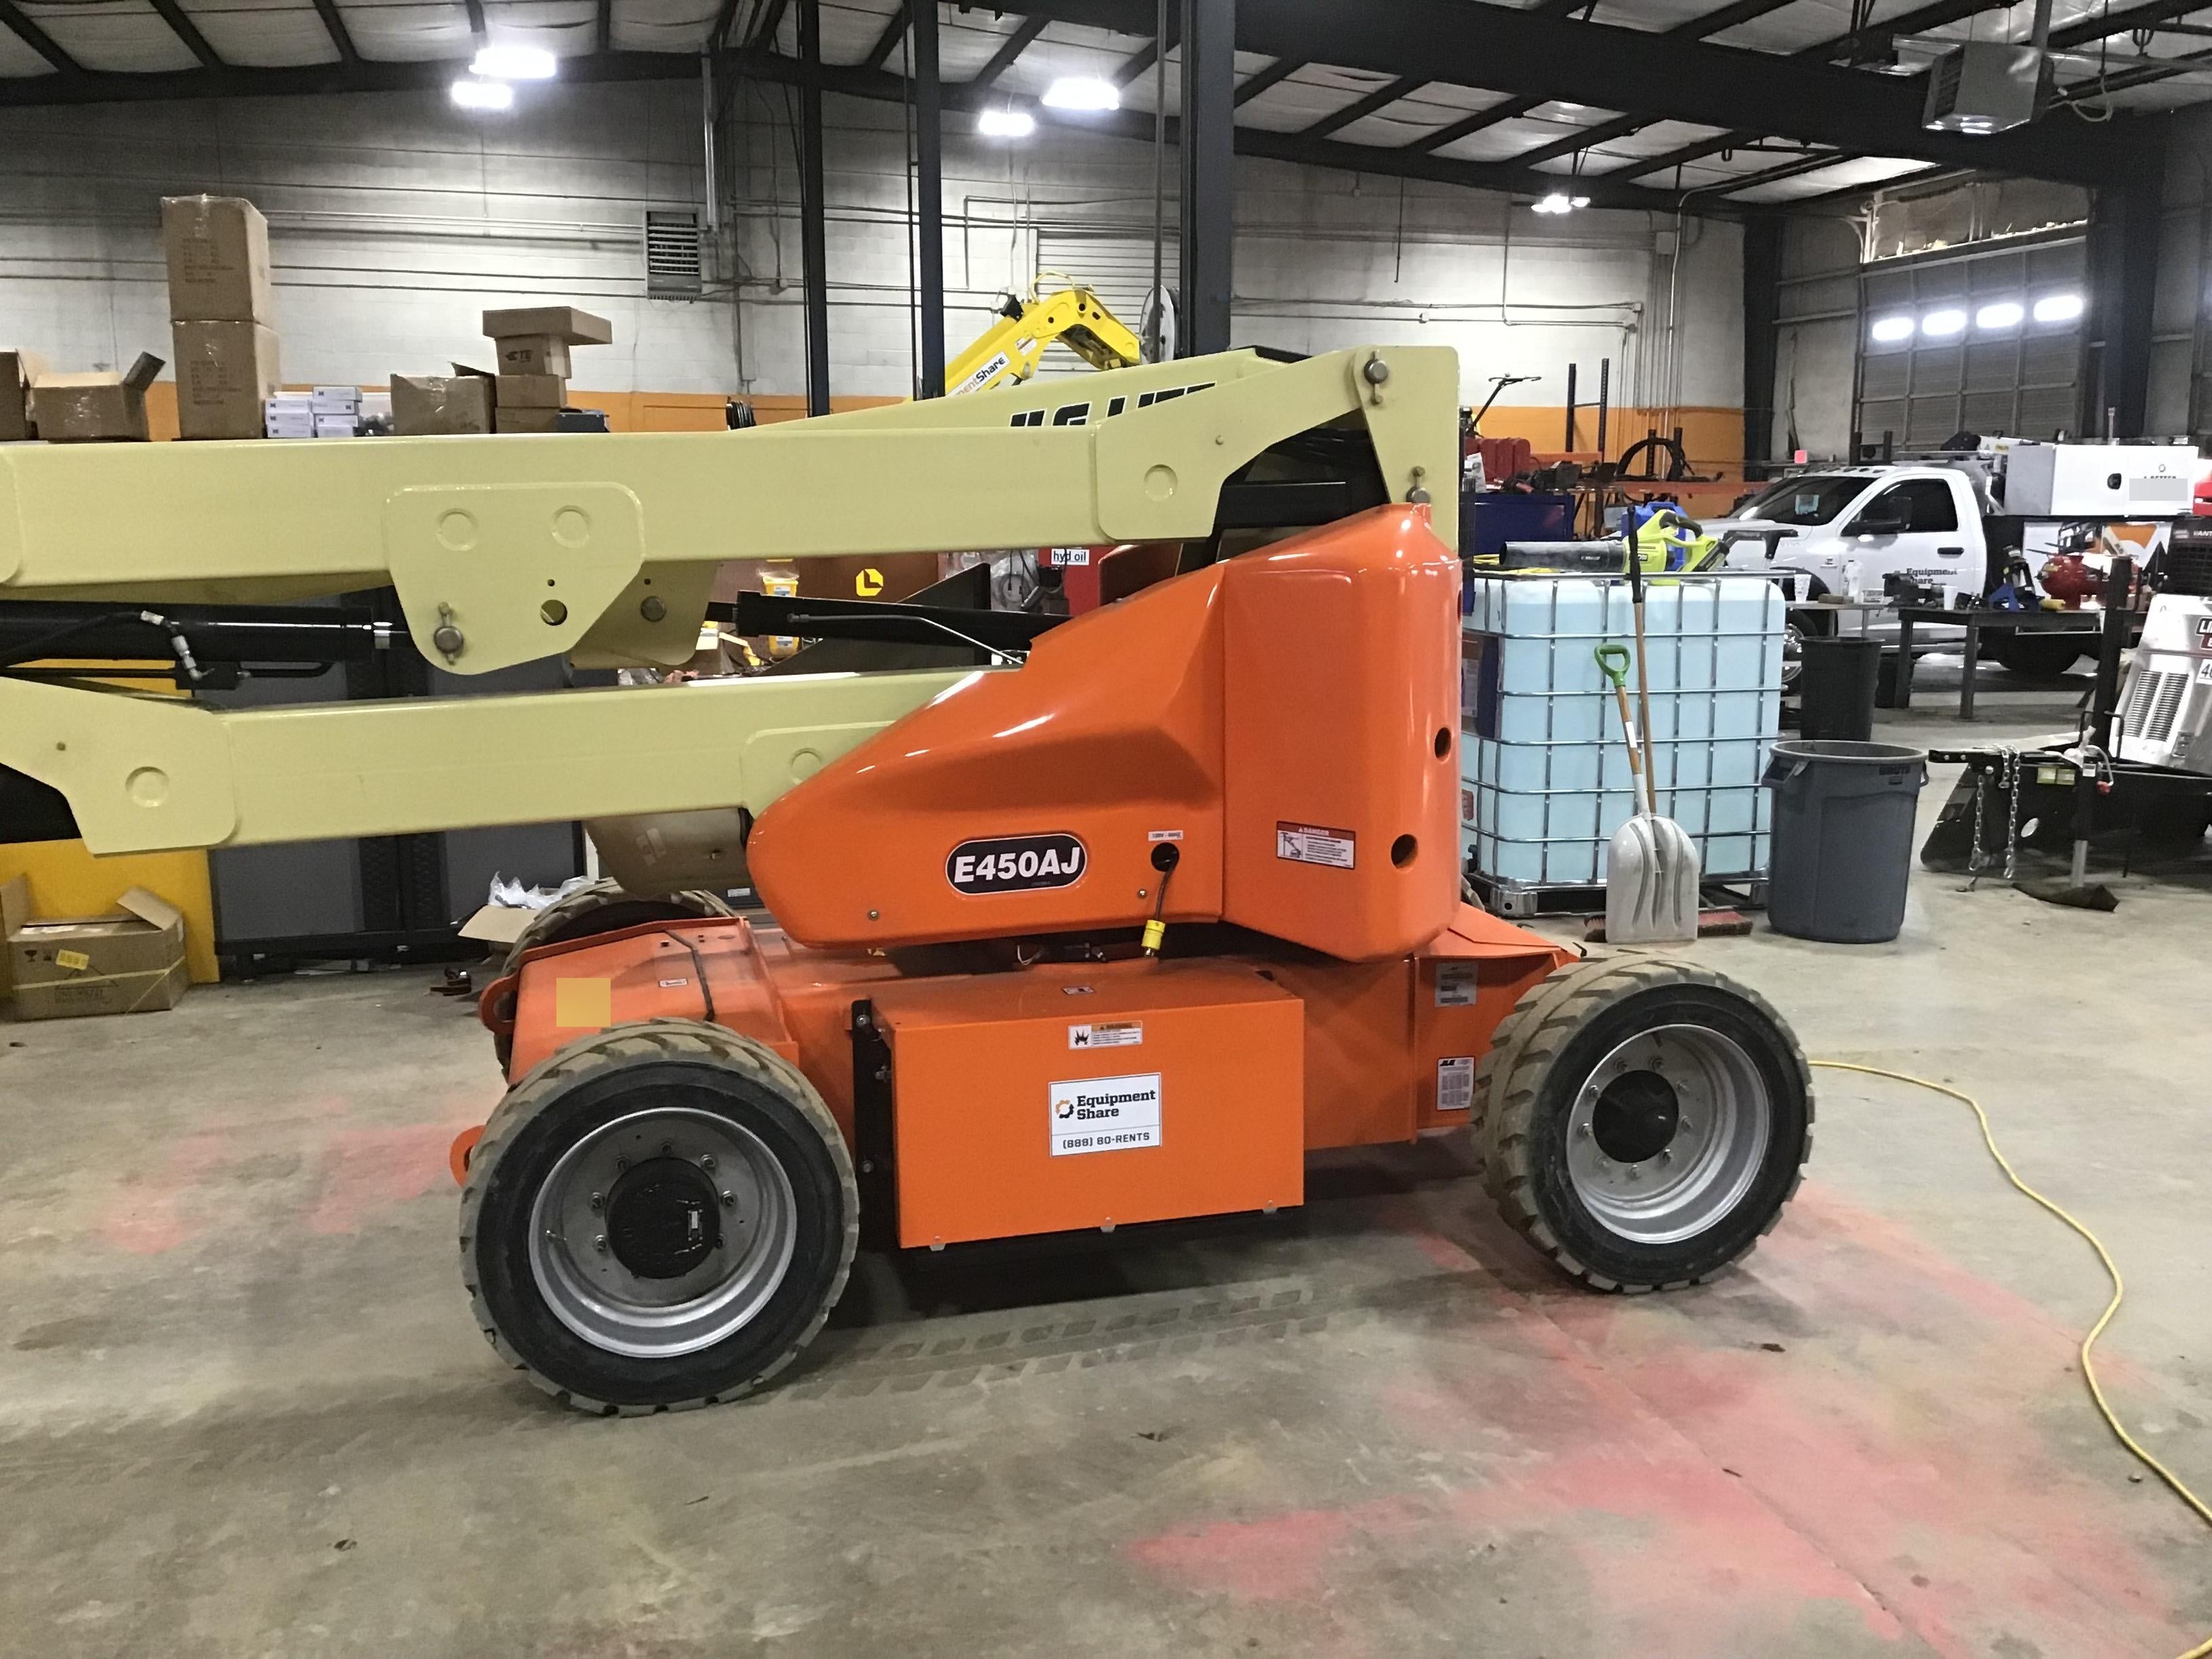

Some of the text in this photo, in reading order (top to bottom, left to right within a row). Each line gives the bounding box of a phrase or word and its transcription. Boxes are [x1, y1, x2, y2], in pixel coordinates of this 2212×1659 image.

[1074, 550, 1086, 561] oil
[954, 847, 1080, 883] E450AJ
[1077, 1090, 1155, 1108] Equipment
[1077, 1108, 1120, 1120] Share
[1063, 1132, 1150, 1149] (888) 80-RENTS
